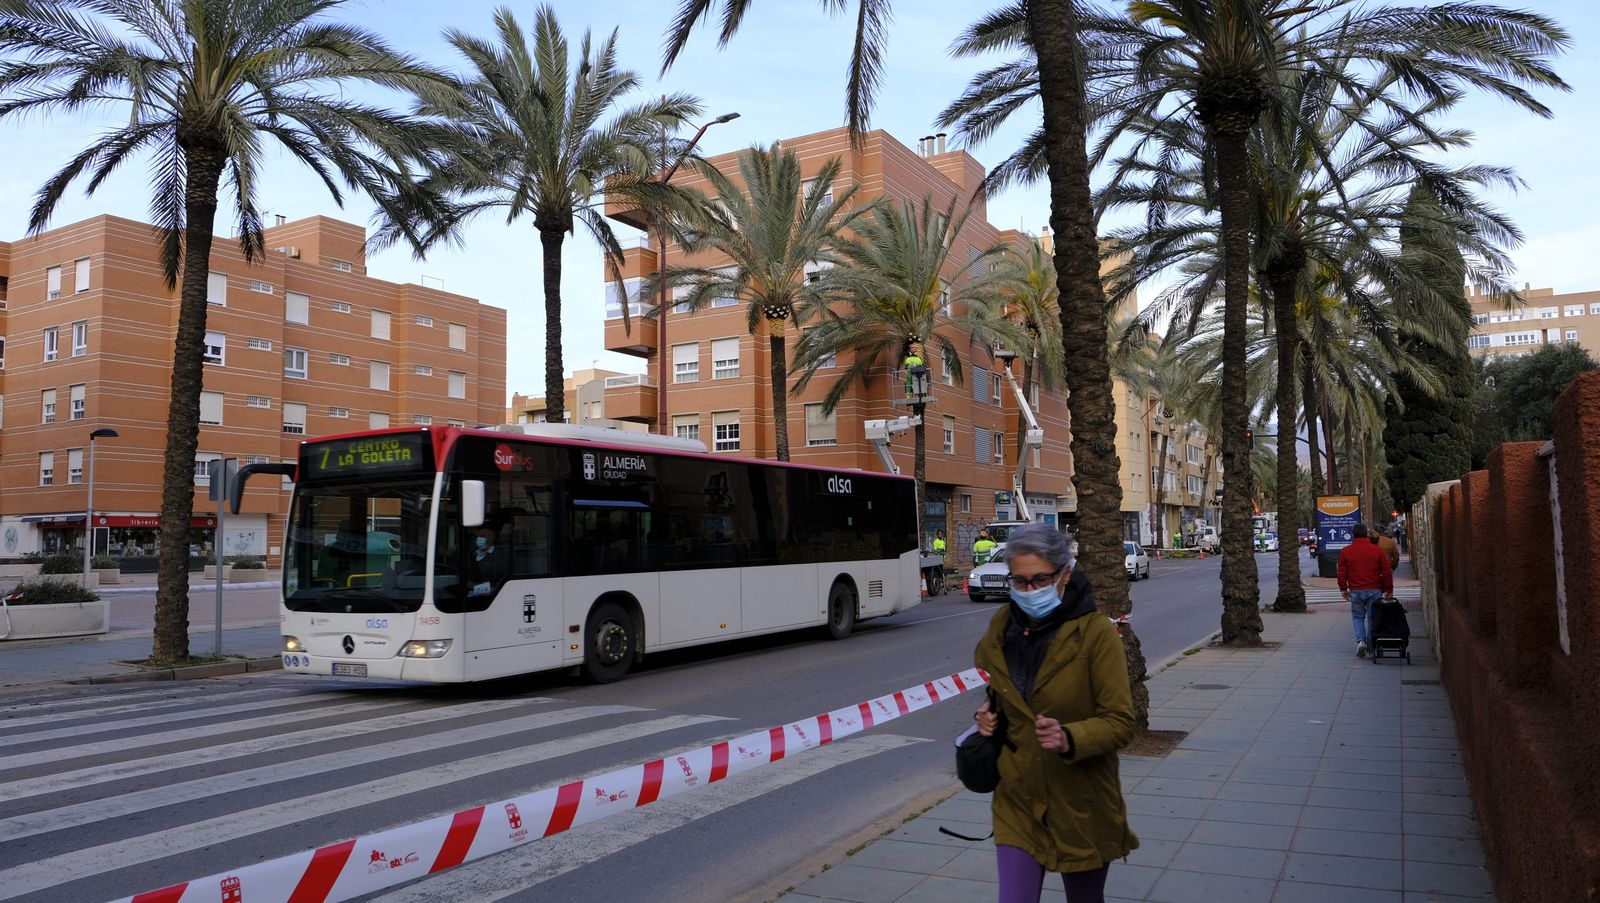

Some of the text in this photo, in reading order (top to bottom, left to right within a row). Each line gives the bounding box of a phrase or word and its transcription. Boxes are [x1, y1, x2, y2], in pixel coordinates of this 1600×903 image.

[320, 447, 330, 470] 7
[338, 448, 411, 466] LA GOLETA
[603, 455, 647, 471] ALMERÍA
[603, 470, 627, 480] CIUDAD
[827, 474, 852, 494] alsa
[365, 617, 389, 629] alsa
